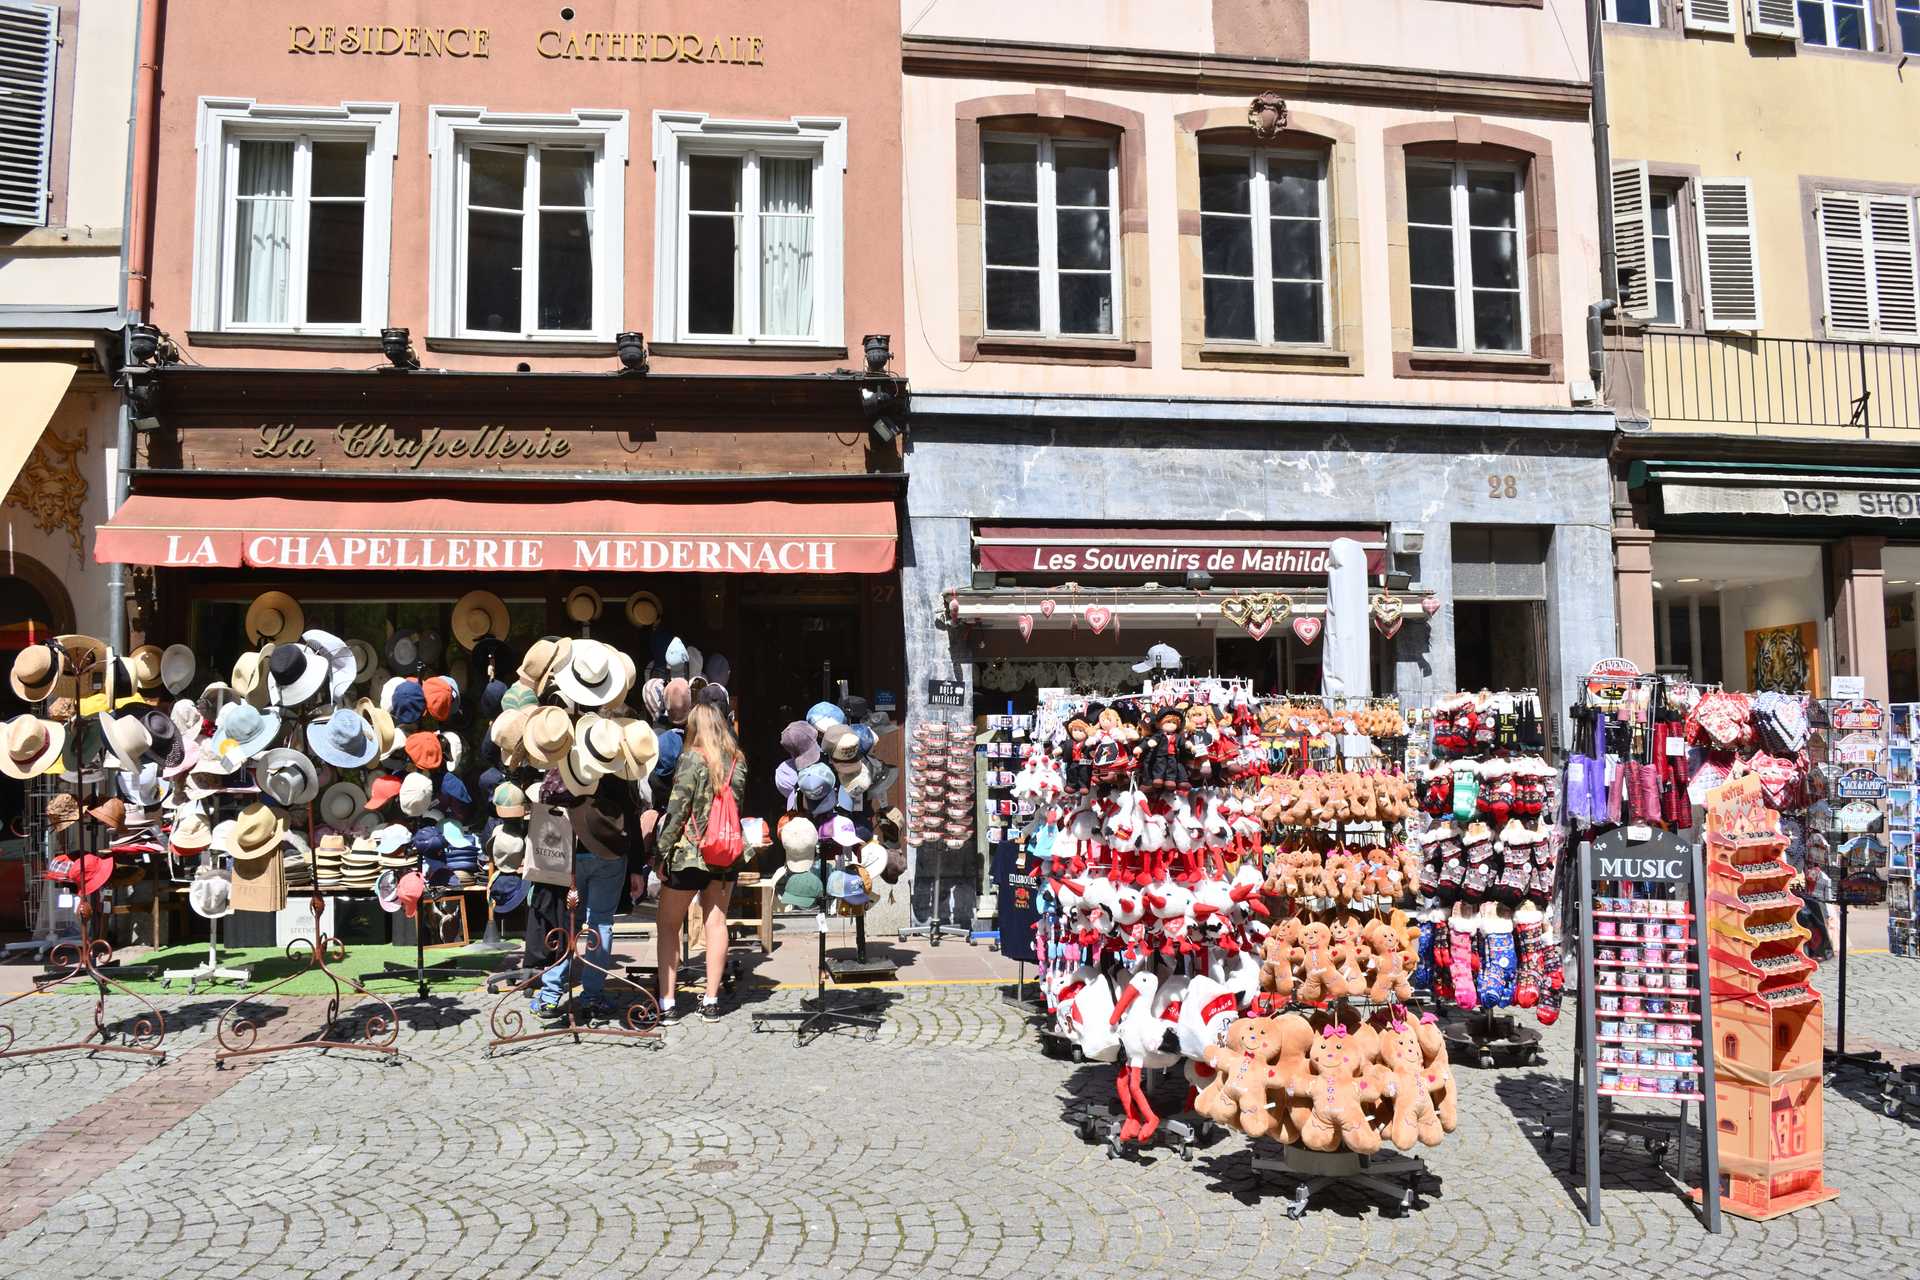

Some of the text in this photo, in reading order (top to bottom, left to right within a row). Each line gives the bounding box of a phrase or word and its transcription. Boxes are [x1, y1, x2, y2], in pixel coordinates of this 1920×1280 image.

[288, 24, 764, 66] RESIDENCE CATHEDRALE
[252, 423, 571, 469] La Chapellerie
[1488, 475, 1517, 498] 28
[1784, 490, 1839, 513] POP
[165, 535, 836, 570] LA CHAPELLERIE MEDERNACH
[1033, 549, 1077, 570] Les
[1082, 549, 1200, 571] Souvenirs
[1206, 551, 1235, 571] de
[871, 584, 896, 602] 27
[535, 847, 567, 860] STETSON
[1599, 857, 1683, 879] MUSIC
